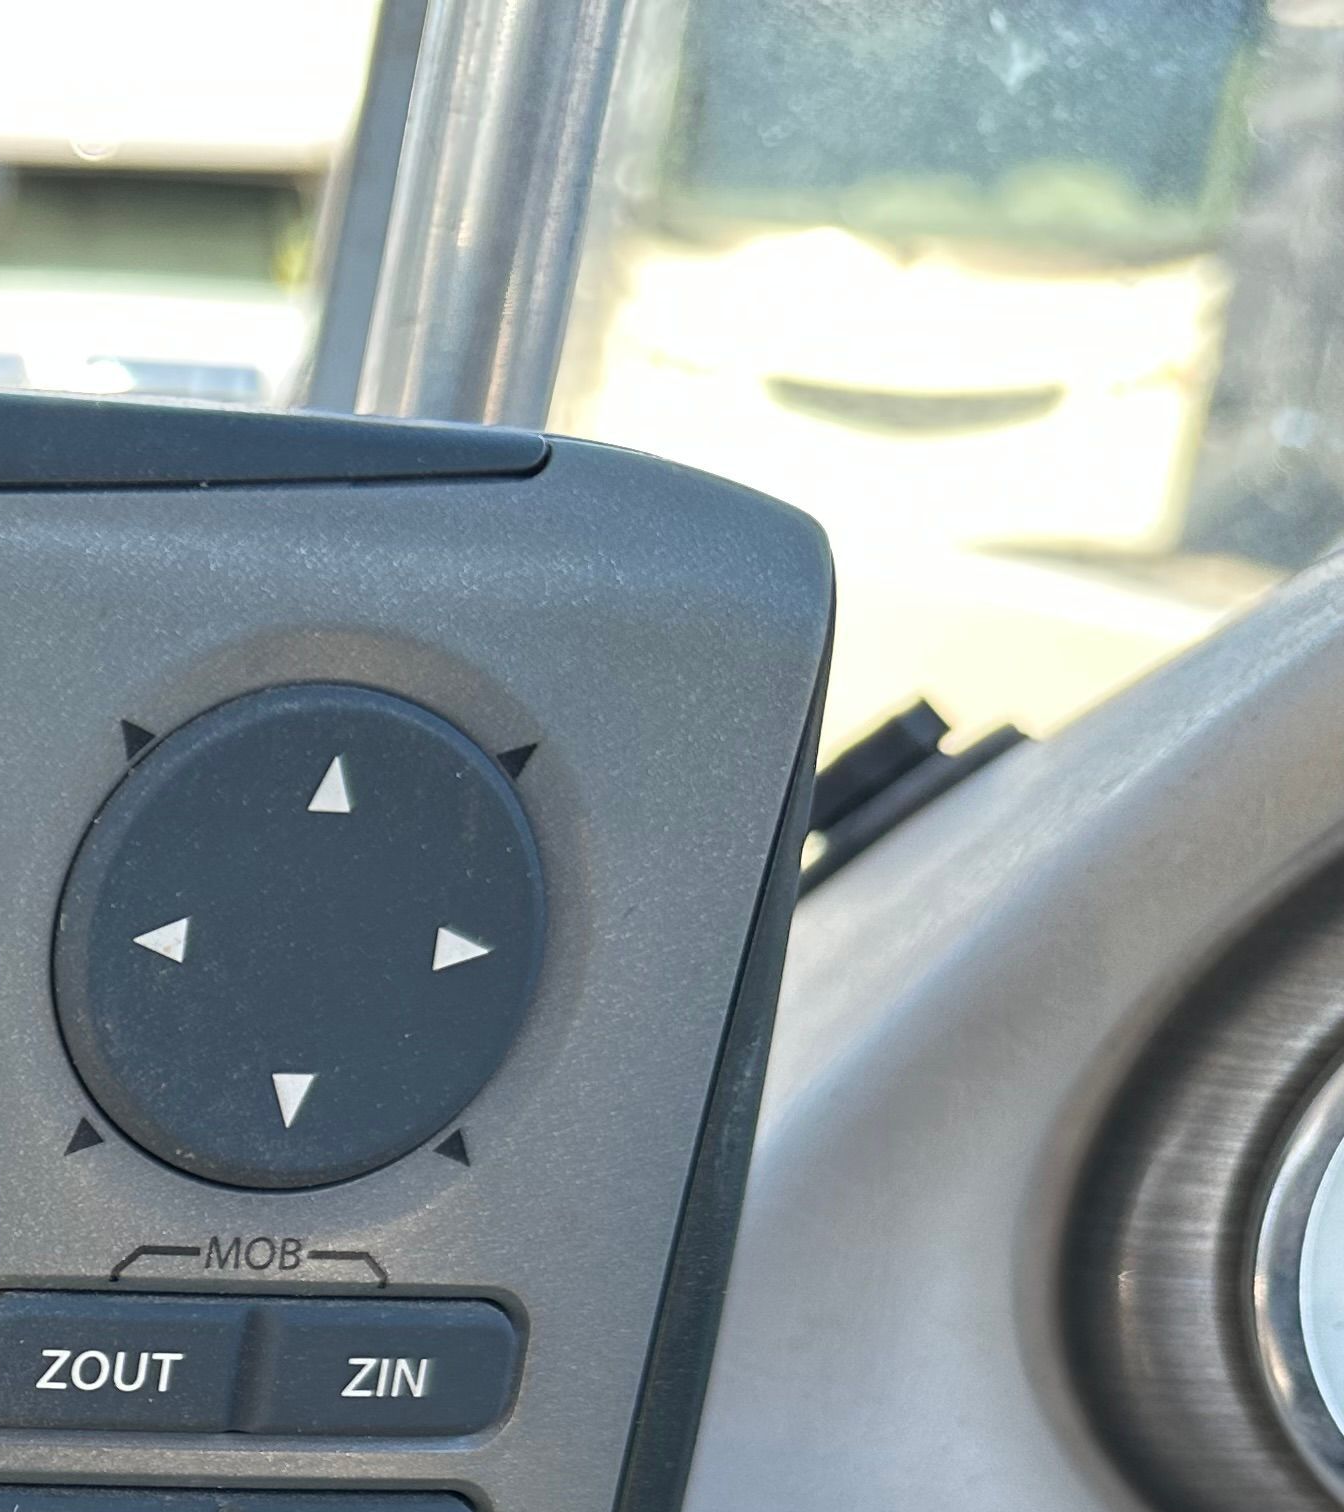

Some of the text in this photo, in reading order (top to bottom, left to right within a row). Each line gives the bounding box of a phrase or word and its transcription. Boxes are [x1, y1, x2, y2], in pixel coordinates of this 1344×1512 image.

[203, 1236, 304, 1271] MOB
[35, 1349, 183, 1393] ZOUT
[340, 1357, 429, 1398] ZIN
